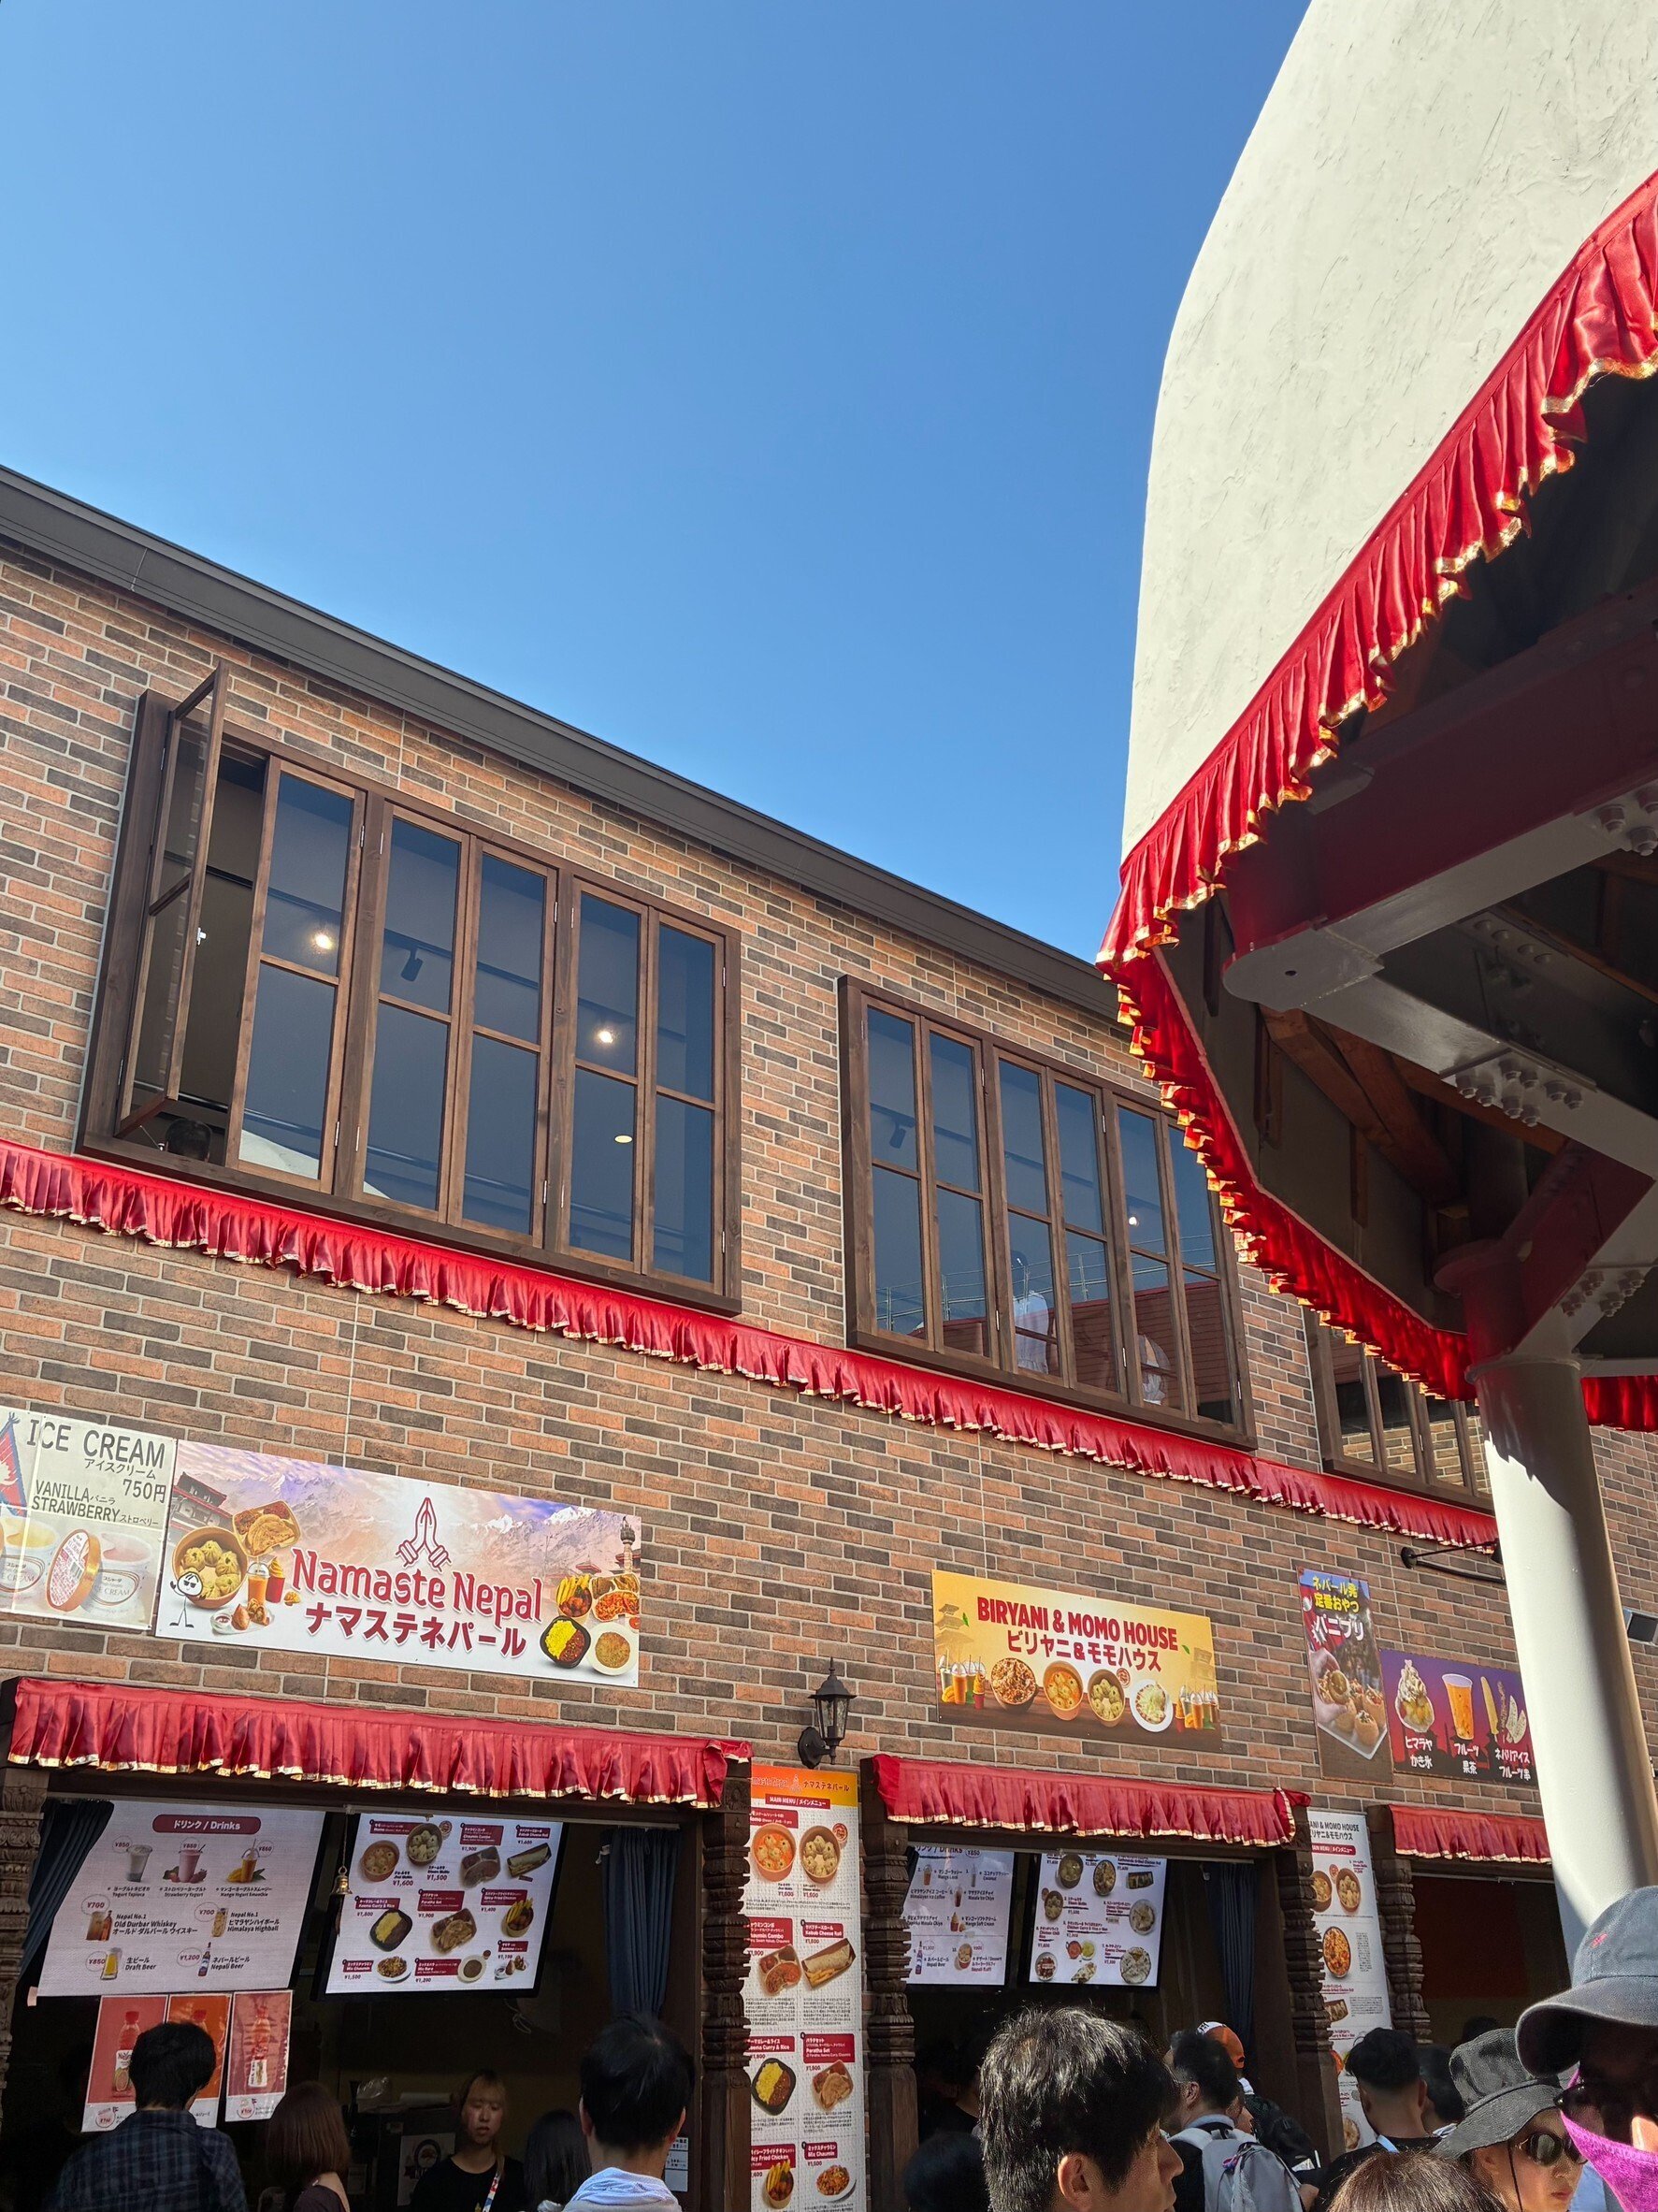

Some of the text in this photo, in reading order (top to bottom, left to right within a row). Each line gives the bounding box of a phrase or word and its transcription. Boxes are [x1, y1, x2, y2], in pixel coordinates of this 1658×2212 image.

[27, 1419, 166, 1468] ICE CREAM
[84, 1458, 156, 1480] アイスクリーム
[36, 1480, 90, 1503] VANILLA
[123, 1479, 166, 1504] 750円
[31, 1496, 159, 1526] STRAWBERRY ストロベリー
[292, 1547, 543, 1629] Namaste Nepal
[305, 1601, 526, 1658] ナマステネパール
[977, 1597, 1179, 1651] BIRYANI & MOMO HOUSE
[1007, 1629, 1162, 1672] ビリヤニ&モモハウス
[1405, 1735, 1433, 1752] ヒマラヤ
[1454, 1742, 1479, 1757] フルーツ
[1410, 1755, 1434, 1770] かき氷
[174, 1819, 202, 1829] ドリンク
[210, 1821, 241, 1830] Drinks
[151, 1920, 177, 1929] Whiskey
